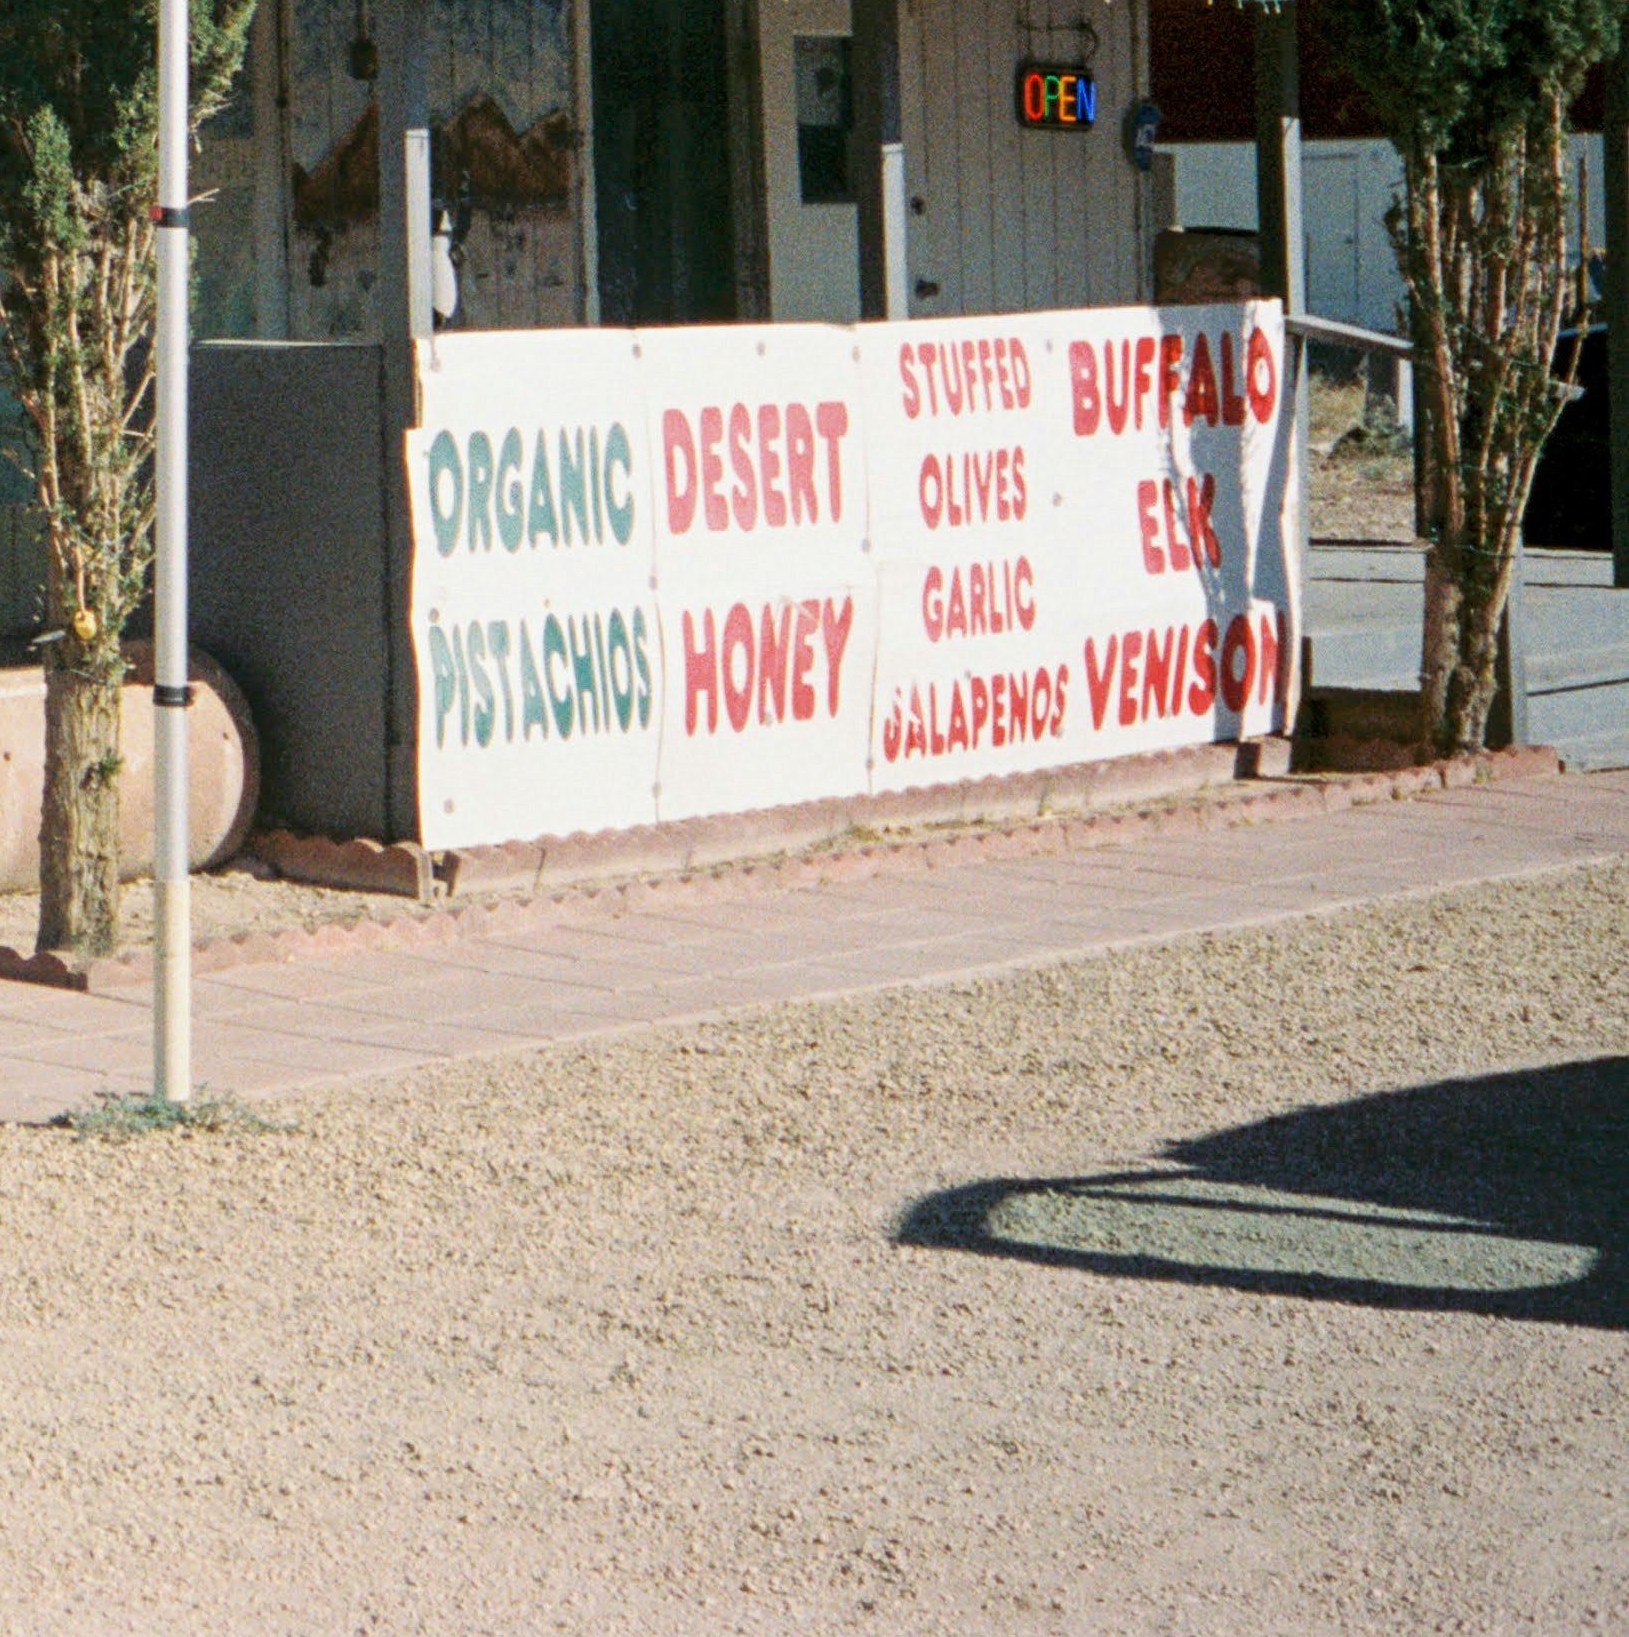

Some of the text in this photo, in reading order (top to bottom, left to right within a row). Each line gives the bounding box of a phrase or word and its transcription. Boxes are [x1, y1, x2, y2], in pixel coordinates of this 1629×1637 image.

[1023, 71, 1096, 124] OPEN
[899, 337, 1032, 420] STUFFED
[1068, 326, 1277, 436] BUFFALO
[428, 421, 635, 559] ORGANIC
[662, 401, 849, 535] DESERT
[918, 445, 1028, 531] OLIVES
[1136, 473, 1222, 575] ELK
[921, 555, 1036, 643] GARLIC
[428, 606, 652, 751] PISTACHIOS
[681, 594, 854, 738] HONEY
[882, 662, 1070, 763] JALAPENOS
[1085, 610, 1289, 731] VENISON
